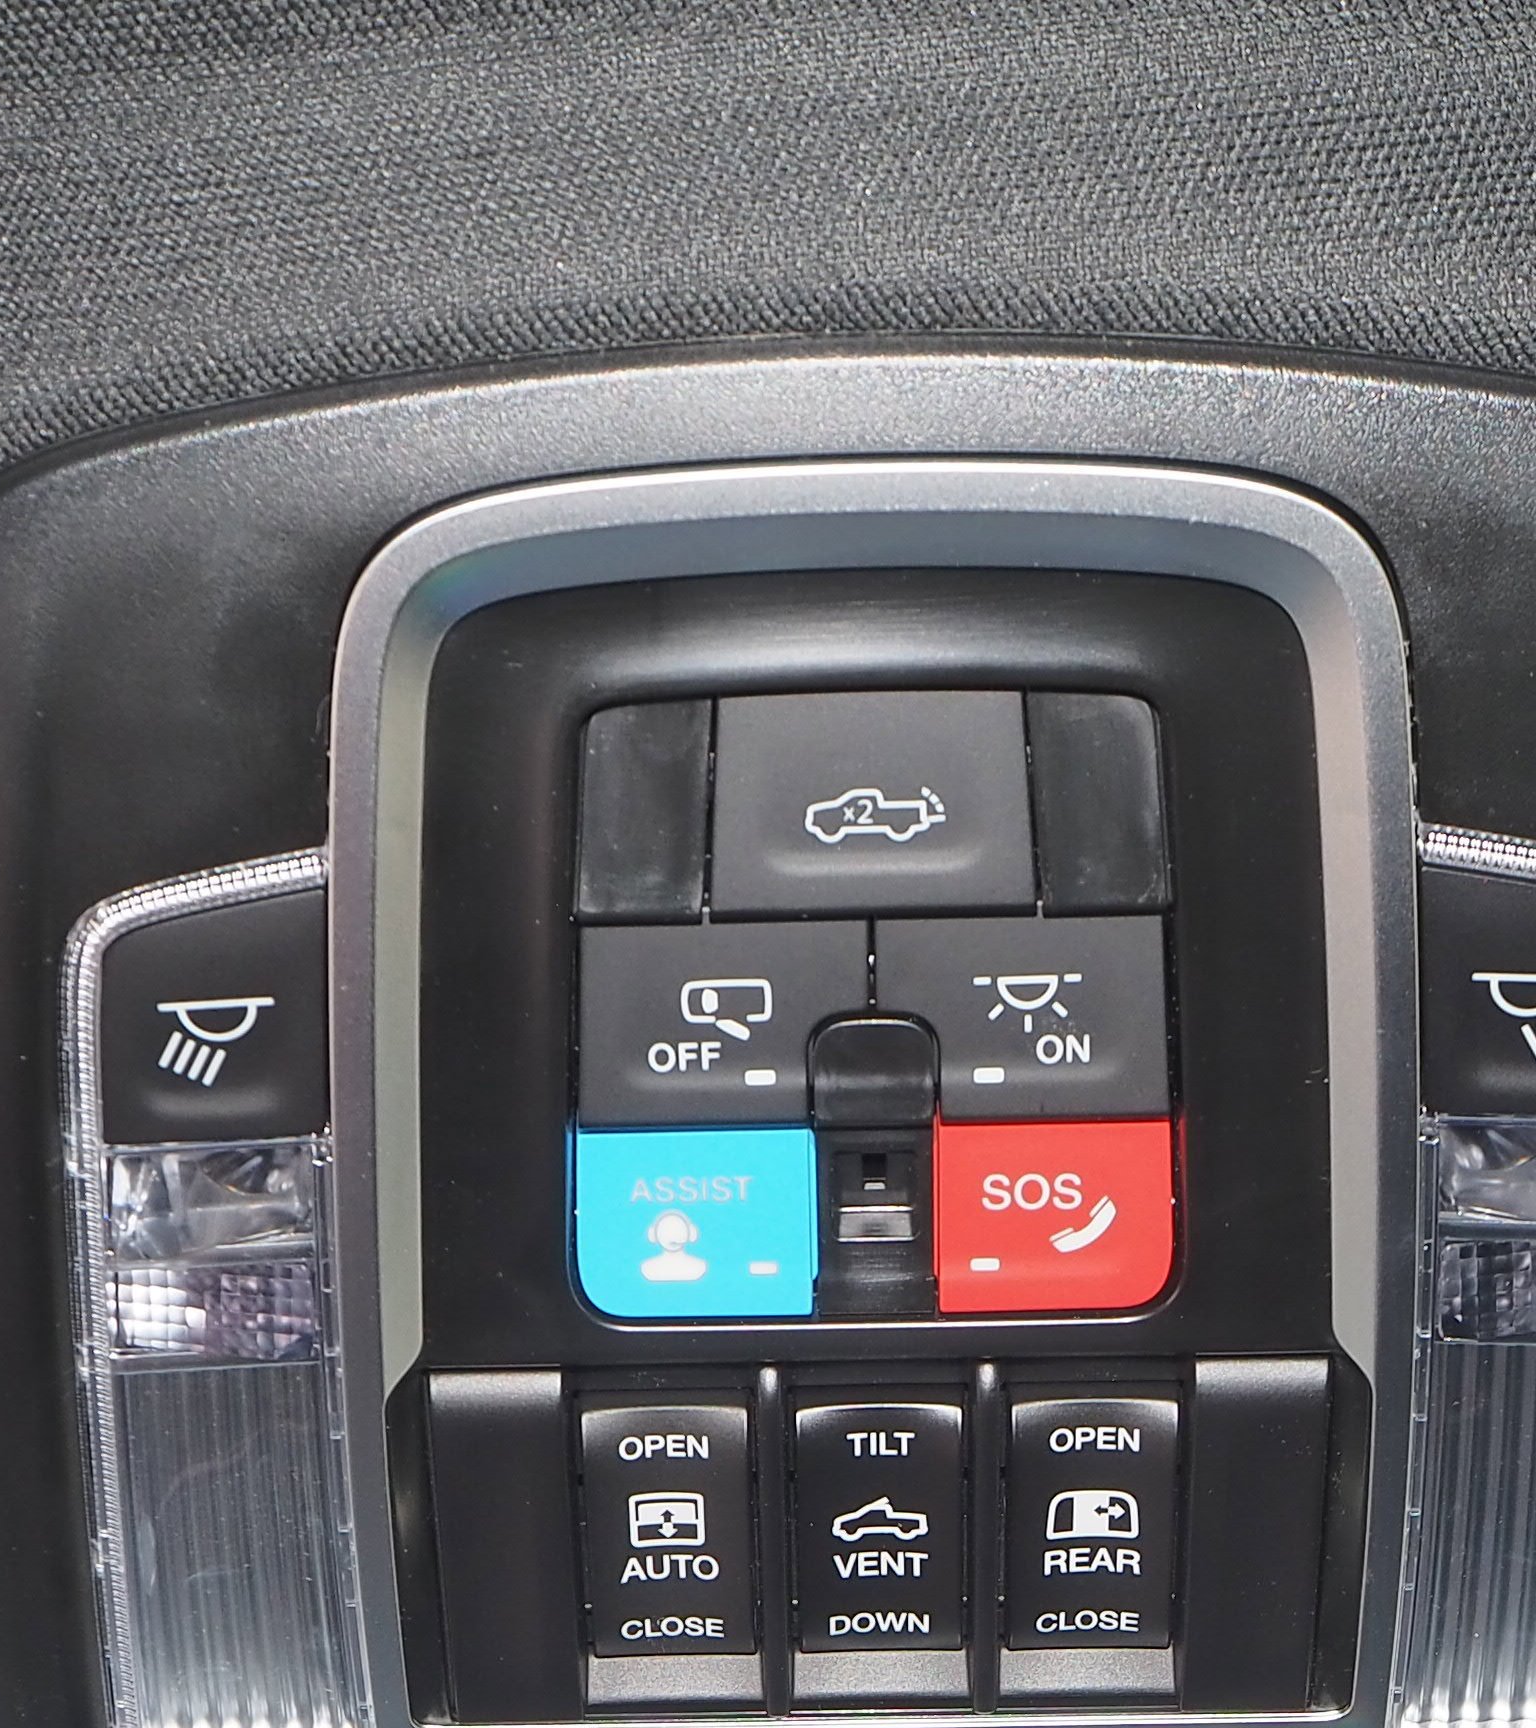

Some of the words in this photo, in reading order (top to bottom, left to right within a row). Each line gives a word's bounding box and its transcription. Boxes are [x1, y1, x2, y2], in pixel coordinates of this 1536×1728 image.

[647, 1041, 722, 1073] OFF
[1035, 1034, 1091, 1065] ON
[630, 1176, 753, 1203] ASSIST
[981, 1171, 1084, 1212] SOS
[618, 1434, 711, 1463] OPEN
[847, 1431, 916, 1459] TILT
[1048, 1426, 1142, 1455] OPEN
[620, 1555, 721, 1585] AUTO
[833, 1551, 929, 1580] VENT
[1043, 1547, 1143, 1577] REAR
[620, 1615, 726, 1641] CLOSE
[829, 1611, 931, 1637] DOWN
[1036, 1610, 1141, 1635] CLOSE
